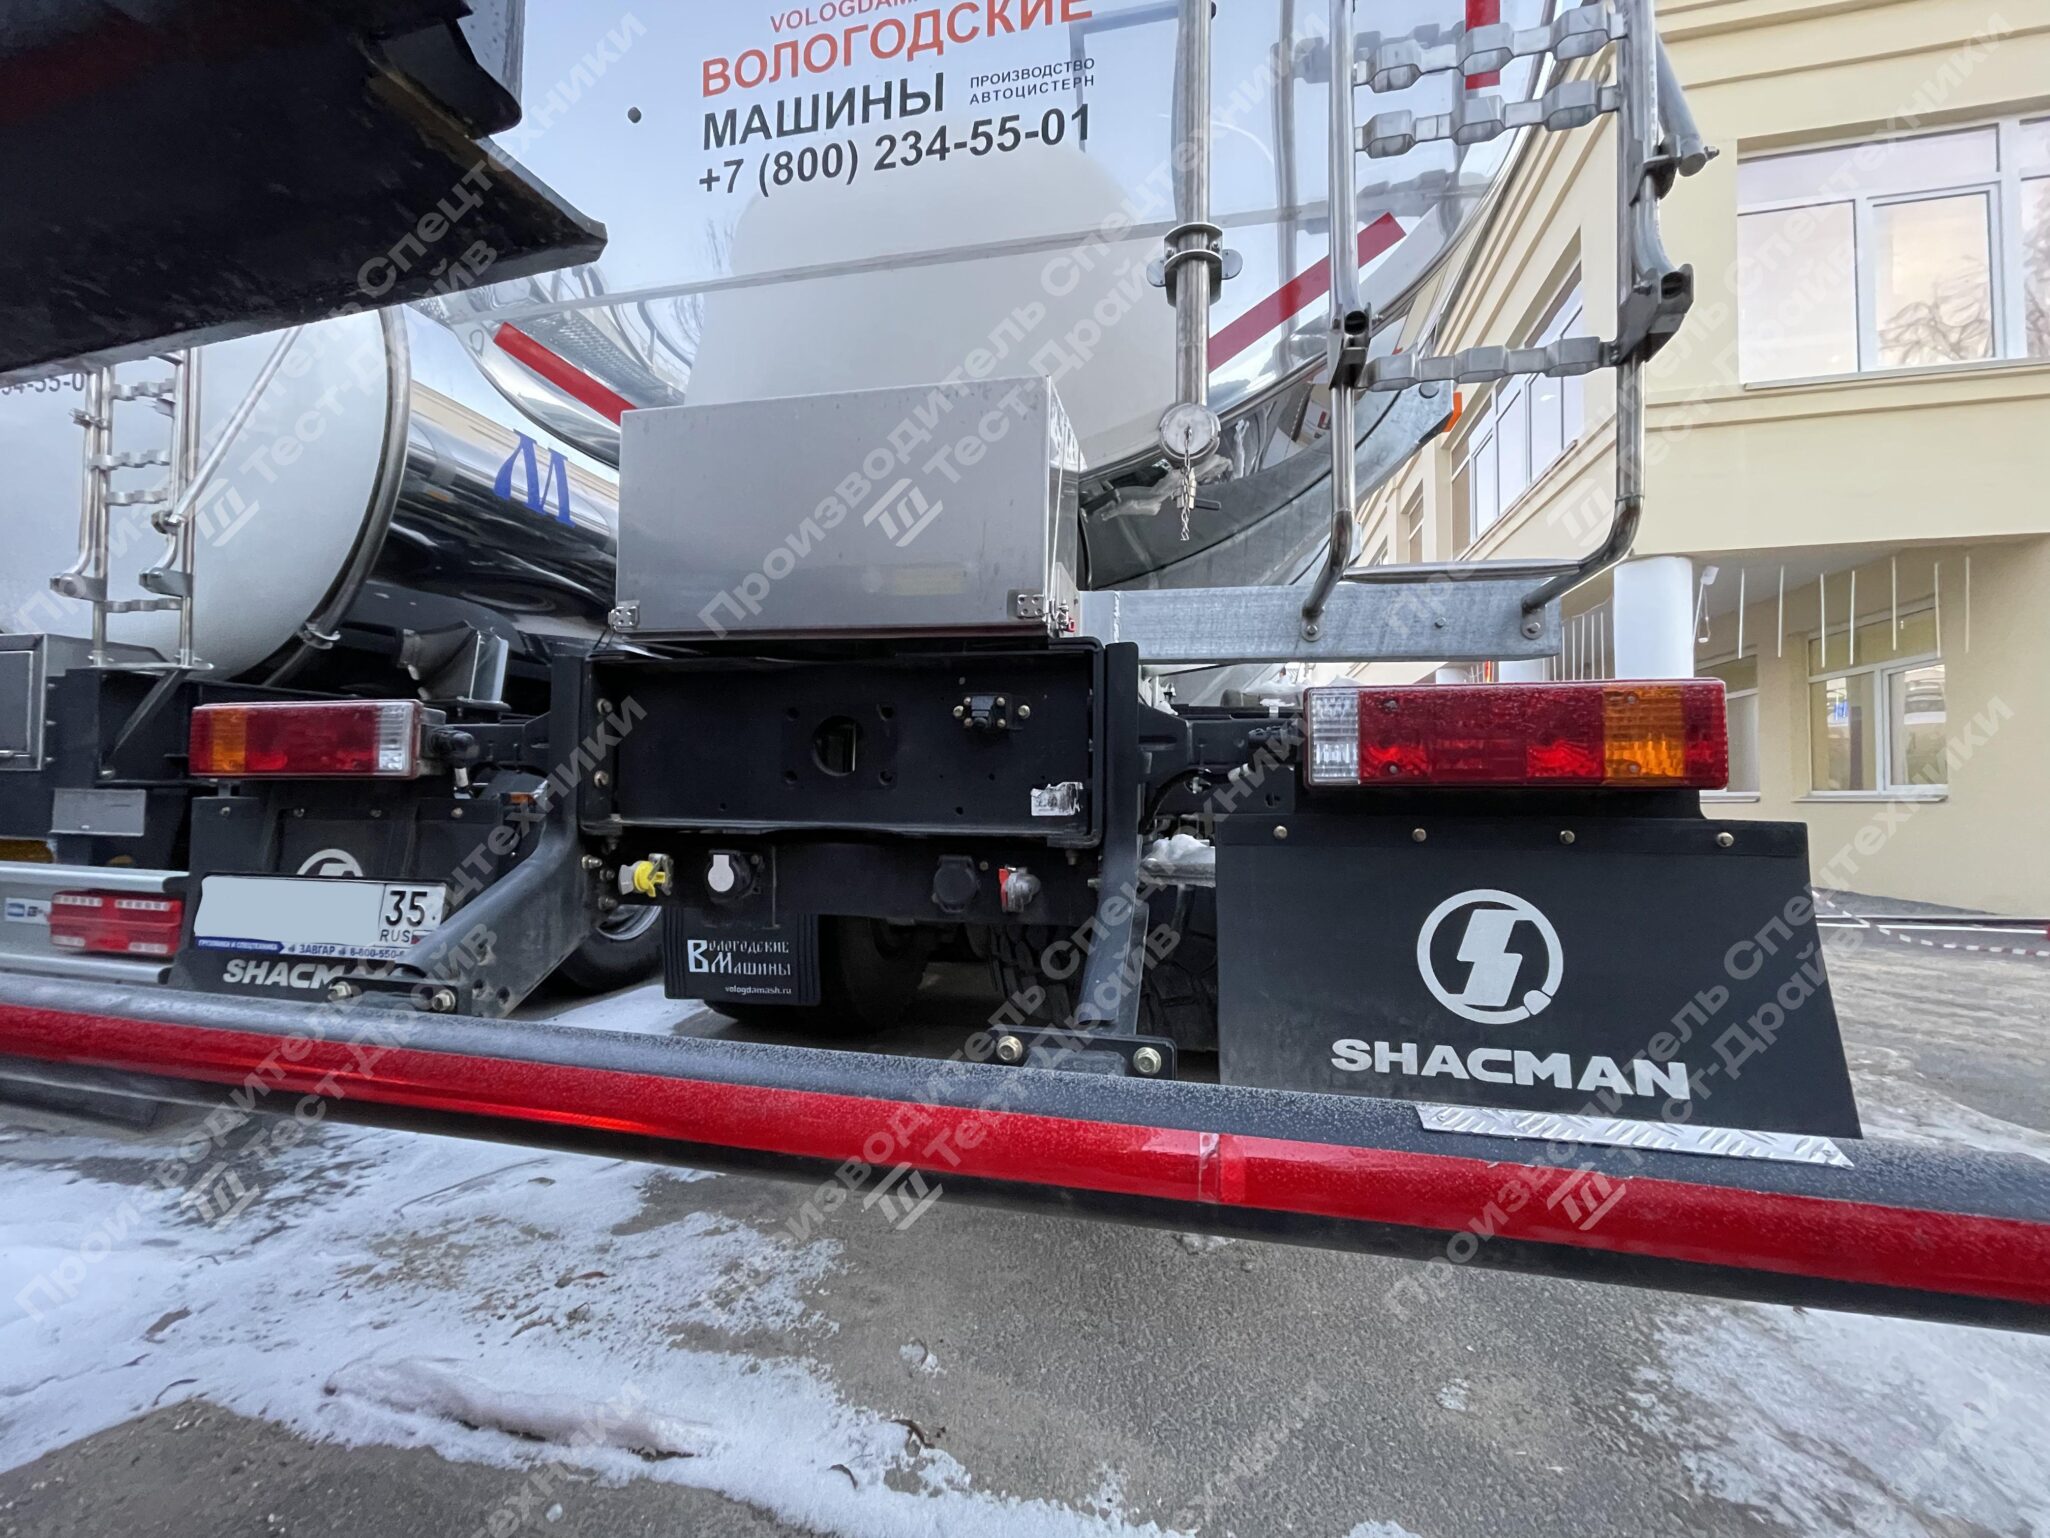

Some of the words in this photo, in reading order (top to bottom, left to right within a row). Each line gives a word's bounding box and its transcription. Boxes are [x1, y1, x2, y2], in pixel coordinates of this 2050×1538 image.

[702, 0, 1093, 98] ВОЛОГОДСКИЕ
[969, 75, 1095, 105] АВТОЦИСТЕРН
[970, 58, 1095, 89] ПРОИЗВОДСТВО
[703, 72, 944, 151] МАШИНЫ
[699, 158, 744, 193] +7
[758, 140, 858, 198] (800)
[874, 103, 1090, 171] 234-55-01
[384, 890, 428, 927] 35
[379, 929, 411, 944] RUS
[724, 985, 792, 996] vologdamash.ru
[1331, 1038, 1690, 1100] SHACMAN
